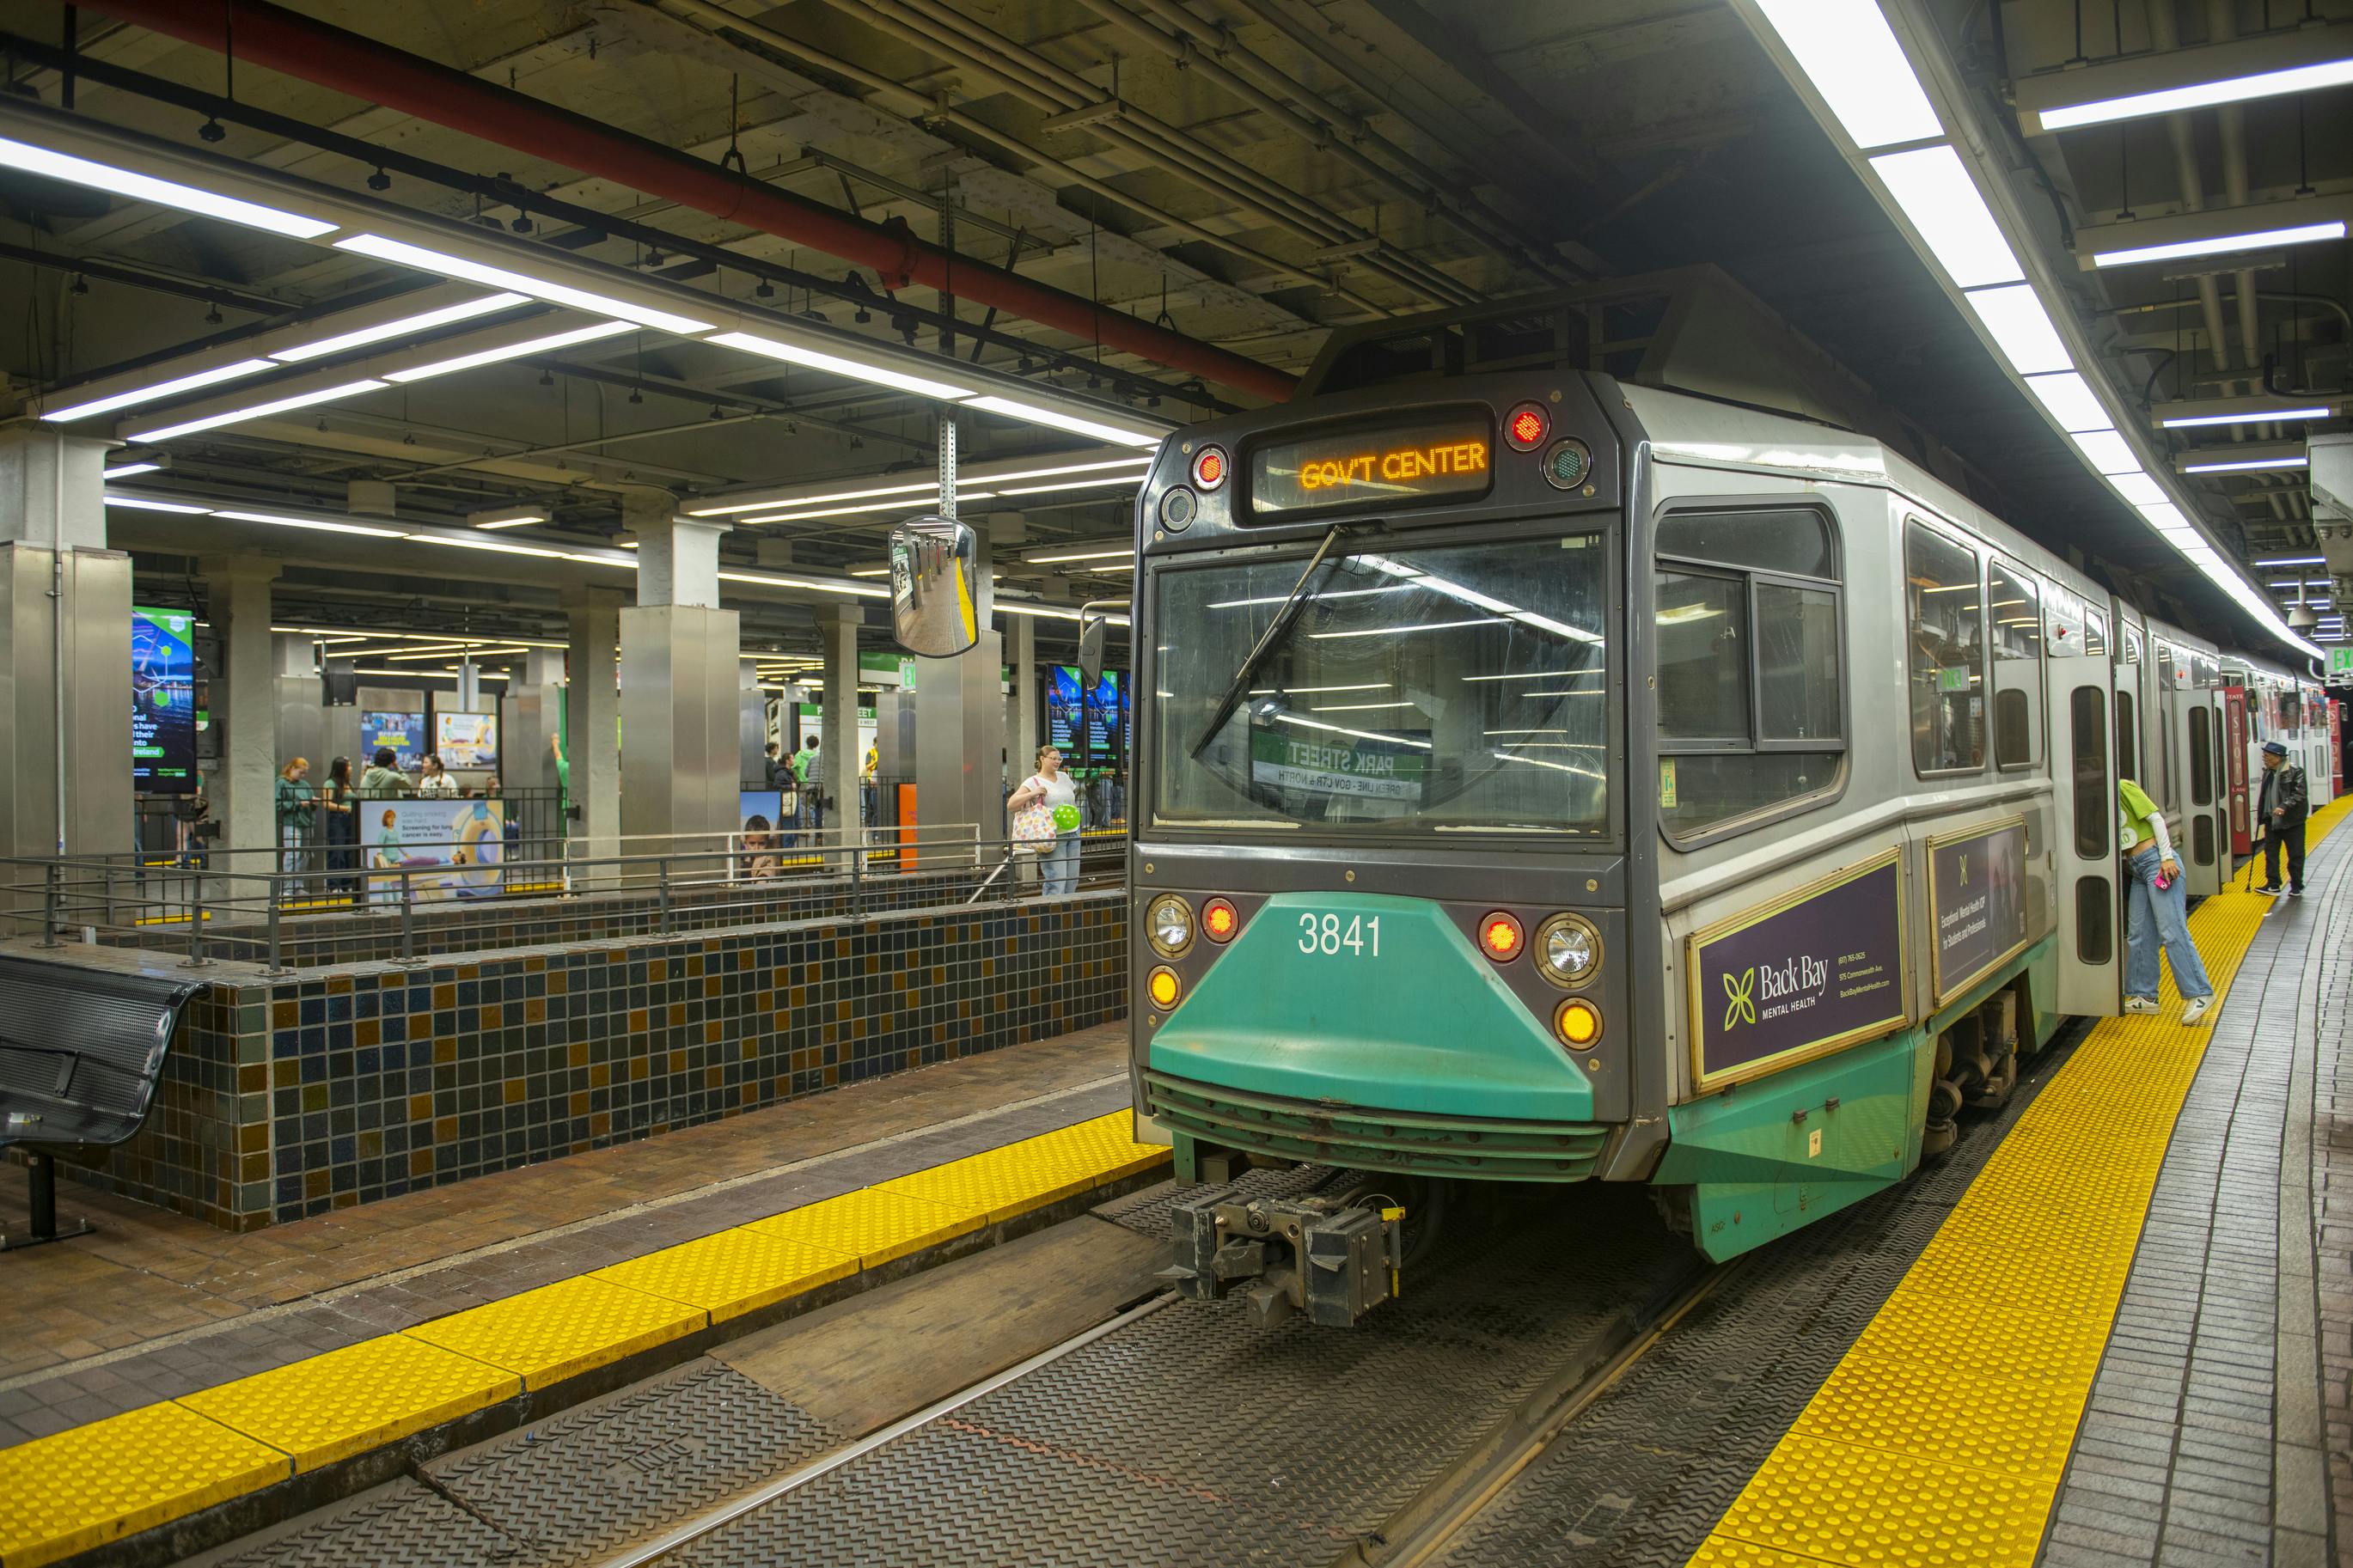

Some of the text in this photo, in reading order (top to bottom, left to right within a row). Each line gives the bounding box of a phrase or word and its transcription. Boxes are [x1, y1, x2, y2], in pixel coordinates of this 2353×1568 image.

[1300, 442, 1485, 489] GOV'T CENTER
[2334, 650, 2353, 670] EX
[905, 666, 915, 686] EX
[858, 709, 872, 717] EET
[1299, 912, 1379, 956] 3841
[1760, 955, 1829, 1001] Back Bay
[1762, 996, 1816, 1021] MENTAL HEALTH
